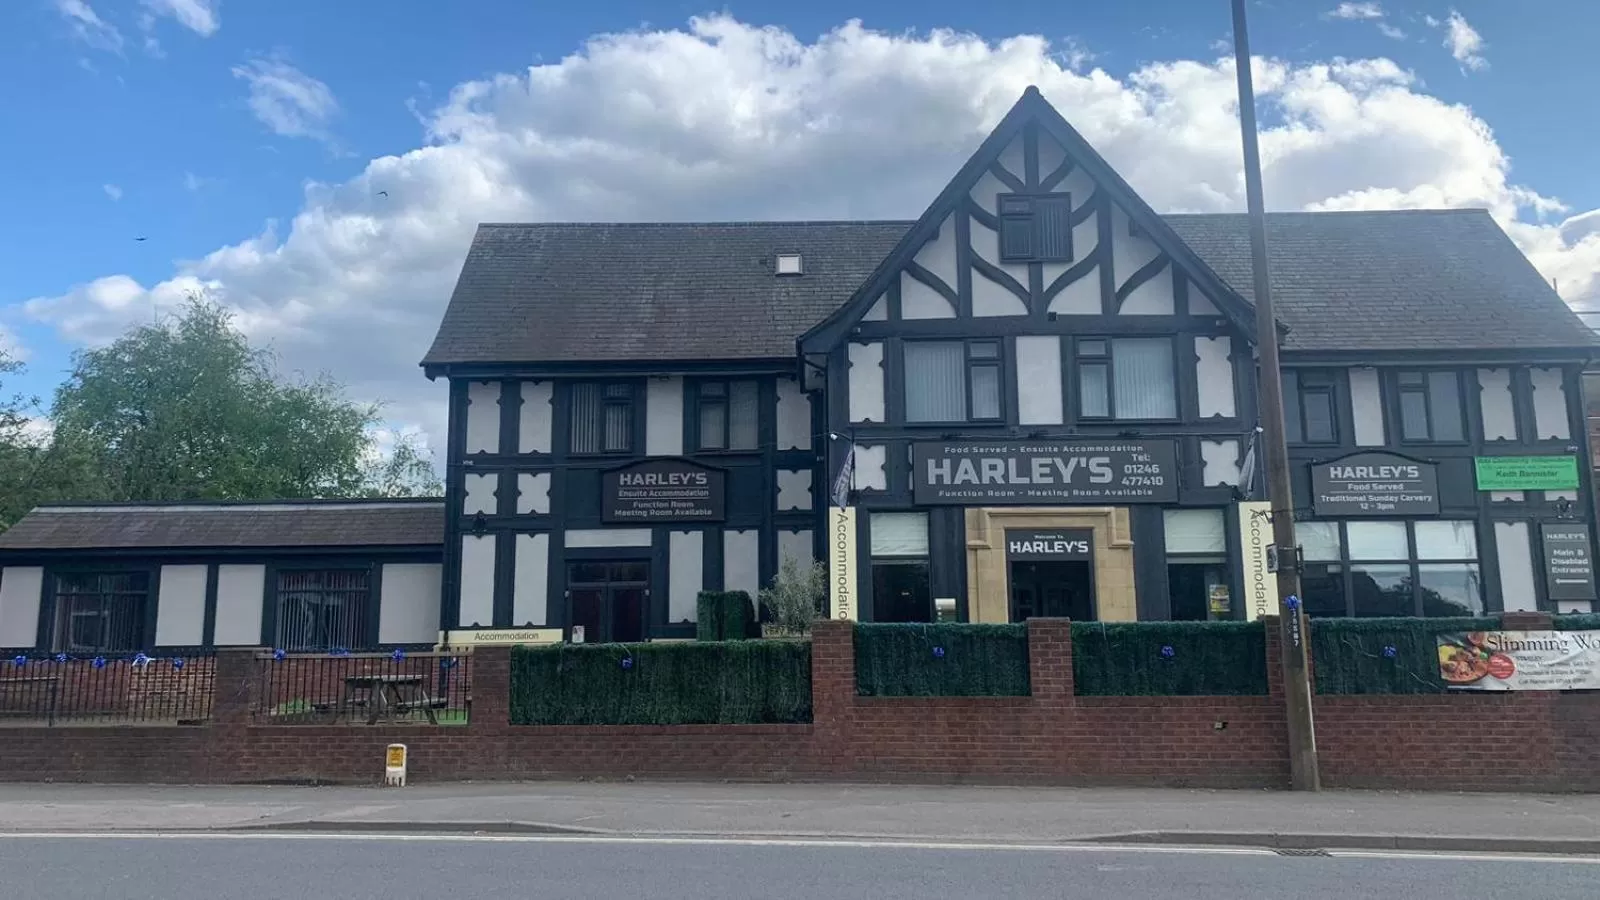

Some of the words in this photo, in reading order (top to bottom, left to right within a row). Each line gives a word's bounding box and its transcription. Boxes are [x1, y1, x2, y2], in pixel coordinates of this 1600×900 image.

[1131, 453, 1150, 461] Tel:
[927, 457, 1113, 485] HARLEY'S
[1124, 464, 1160, 474] 01246
[1330, 466, 1419, 478] HARLEY'S
[620, 472, 707, 485] HARLEY'S
[1121, 476, 1164, 486] 477410
[649, 489, 709, 497] Accommodation
[1028, 489, 1069, 497] Meeting
[1400, 494, 1432, 502] Carvery
[615, 509, 647, 517] Meeting
[1009, 541, 1089, 553] HARLEY'S
[474, 632, 539, 641] Accommodation
[1487, 633, 1569, 655] Slimming
